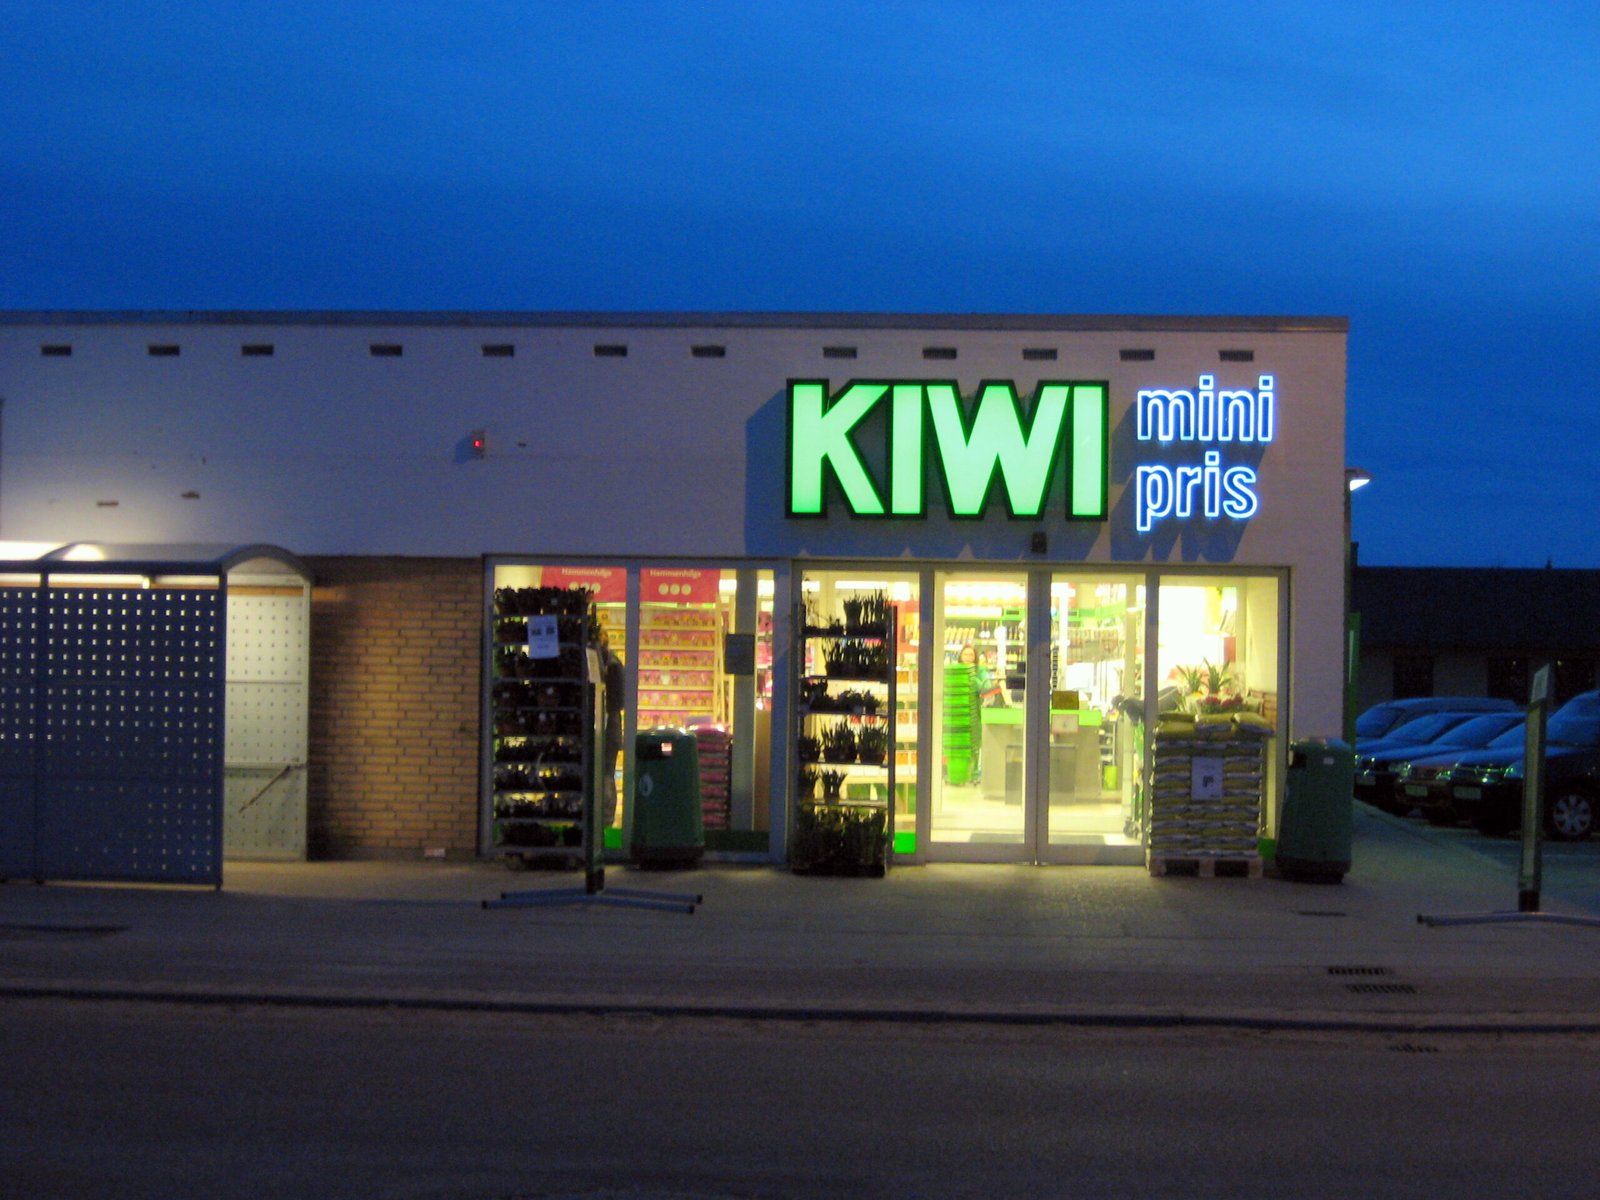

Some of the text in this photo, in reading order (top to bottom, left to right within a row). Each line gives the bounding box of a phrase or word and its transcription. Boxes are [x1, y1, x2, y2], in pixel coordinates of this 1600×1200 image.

[788, 380, 1108, 518] KIWI
[1136, 374, 1275, 443] mini
[1135, 451, 1259, 532] pris
